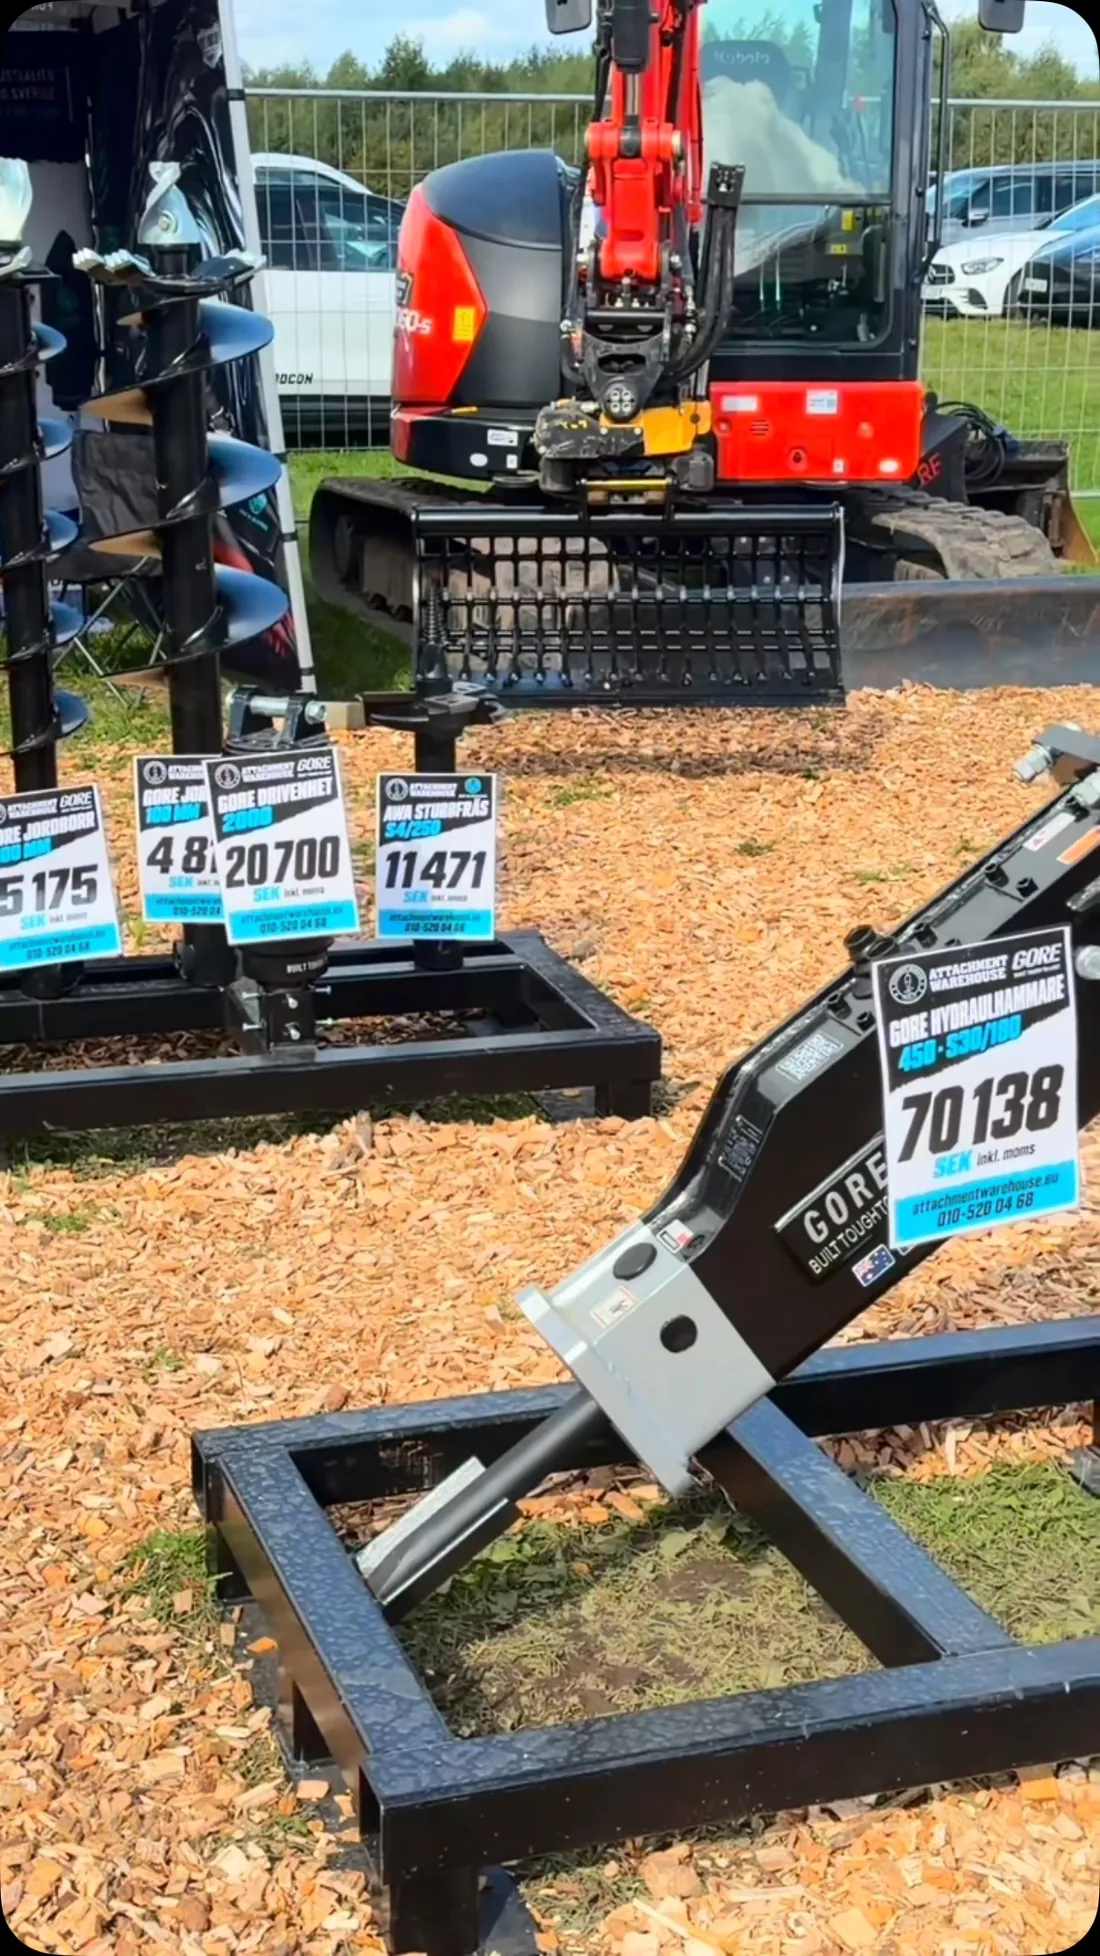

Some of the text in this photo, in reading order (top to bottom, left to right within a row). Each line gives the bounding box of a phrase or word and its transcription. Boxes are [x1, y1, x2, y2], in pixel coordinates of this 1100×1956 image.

[297, 756, 333, 771] GORE
[60, 791, 93, 807] GORE
[143, 787, 180, 807] GORE
[218, 776, 333, 814] GORE DRIVENHET
[222, 806, 272, 833] 2000
[383, 804, 413, 822] AWA
[168, 875, 194, 888] SEK
[253, 886, 280, 902] SEK
[403, 890, 428, 903] SEK
[20, 913, 46, 929] SEK
[928, 954, 1009, 980] ATTACHMENT
[1012, 943, 1063, 971] GORE
[929, 967, 1007, 993] WAREHOUSE
[889, 973, 1065, 1048] GORE HYDRAULHAMMARE
[897, 1038, 937, 1072] 450
[932, 1143, 1037, 1179] SEK inkl. moms
[803, 1151, 888, 1244] GORE
[911, 1172, 1060, 1216] attachmentwarehouse.eu
[937, 1191, 1035, 1227] 010-520 04 68
[808, 1239, 843, 1275] BUILT
